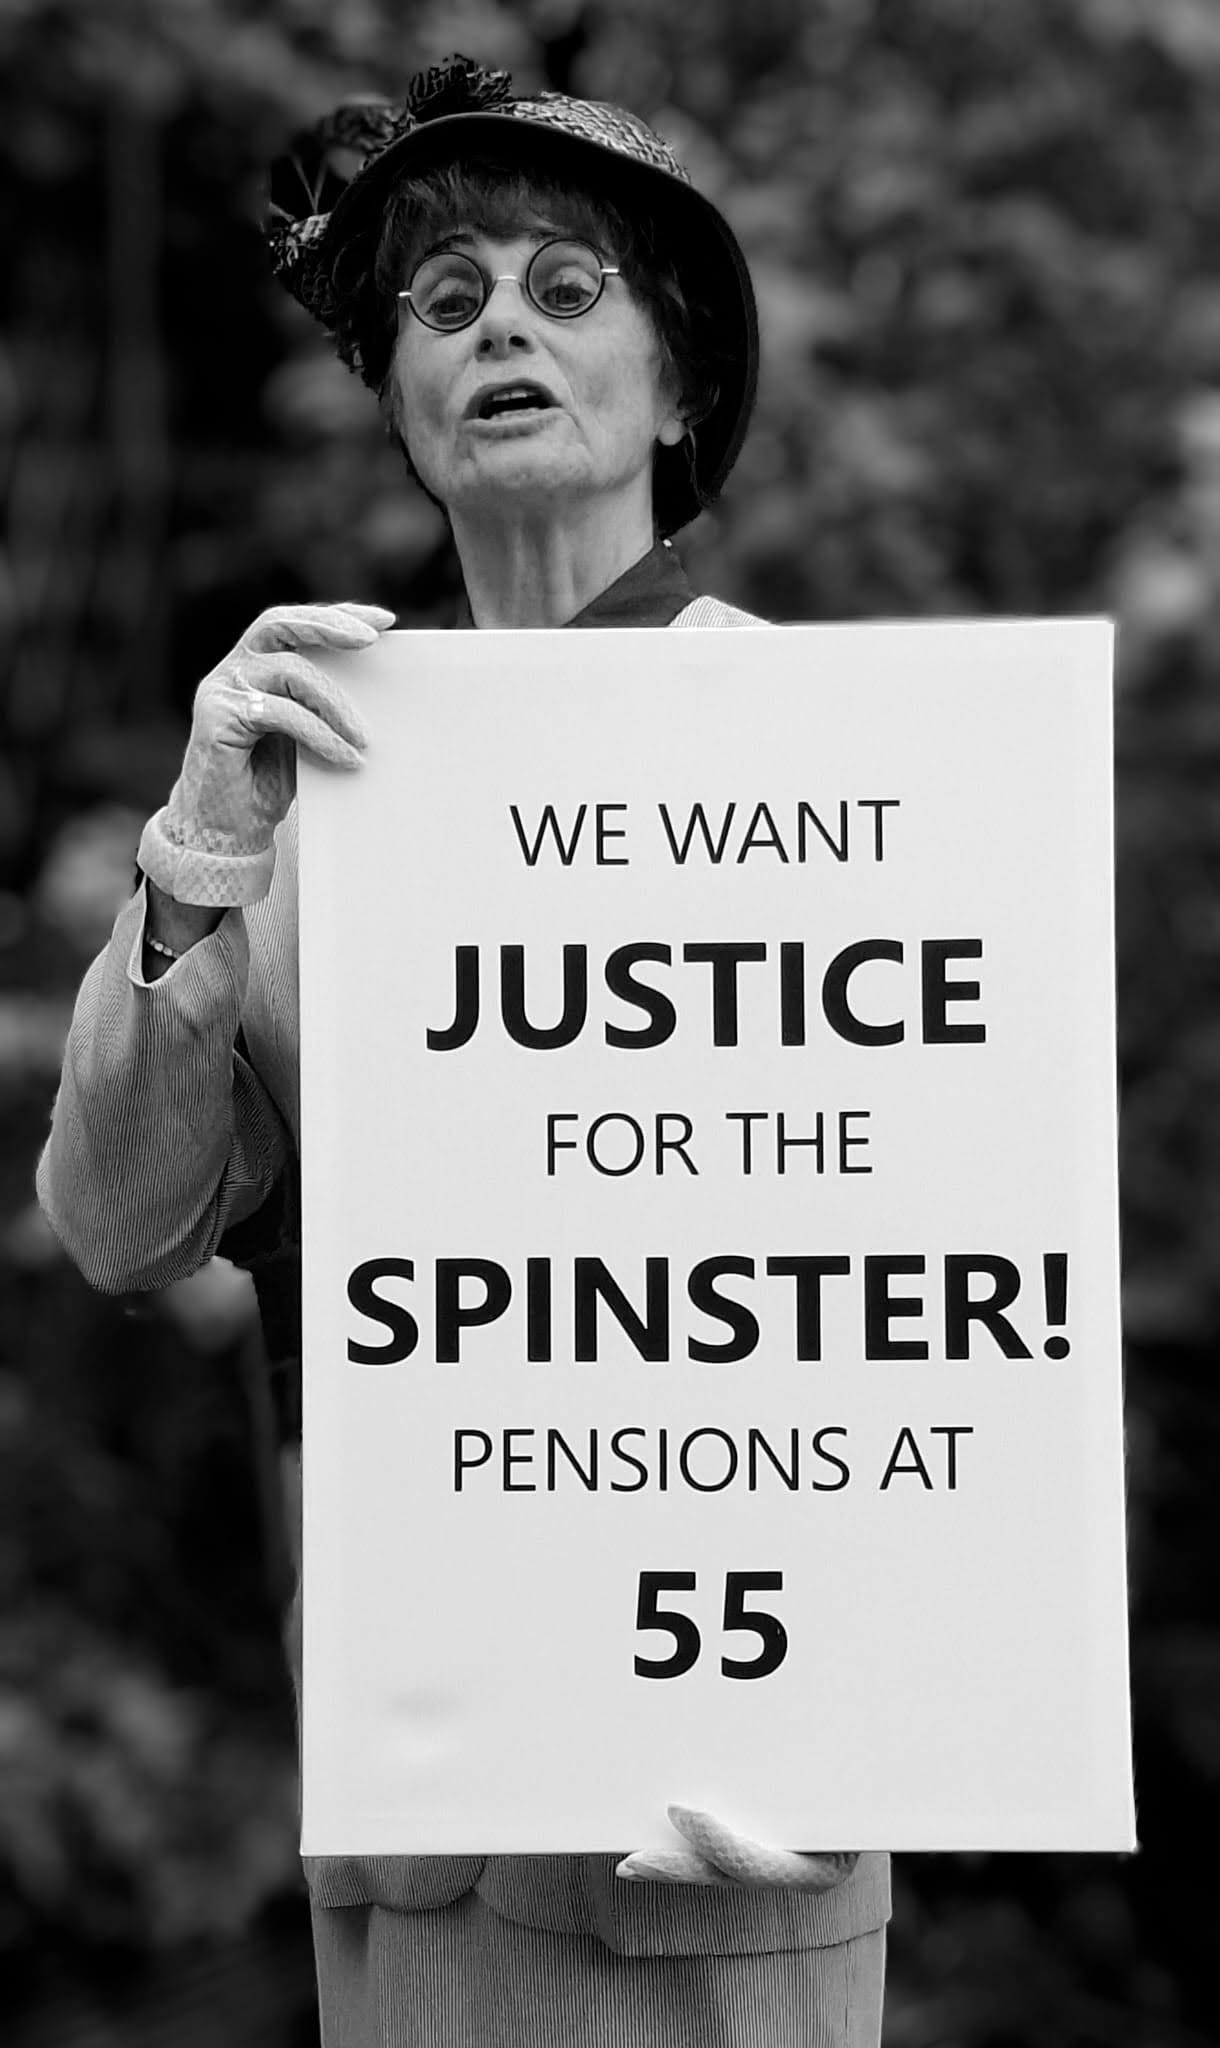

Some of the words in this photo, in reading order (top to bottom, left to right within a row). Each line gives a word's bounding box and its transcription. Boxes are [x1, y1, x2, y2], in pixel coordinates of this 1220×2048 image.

[509, 804, 629, 866] WE
[657, 800, 900, 865] WANT
[426, 938, 986, 1052] JUSTICE
[547, 1113, 698, 1177] FOR
[725, 1111, 873, 1175] THE
[347, 1252, 1071, 1366] SPINSTER!
[454, 1427, 850, 1493] PENSIONS
[879, 1426, 974, 1492] AT
[634, 1571, 788, 1680] 55
